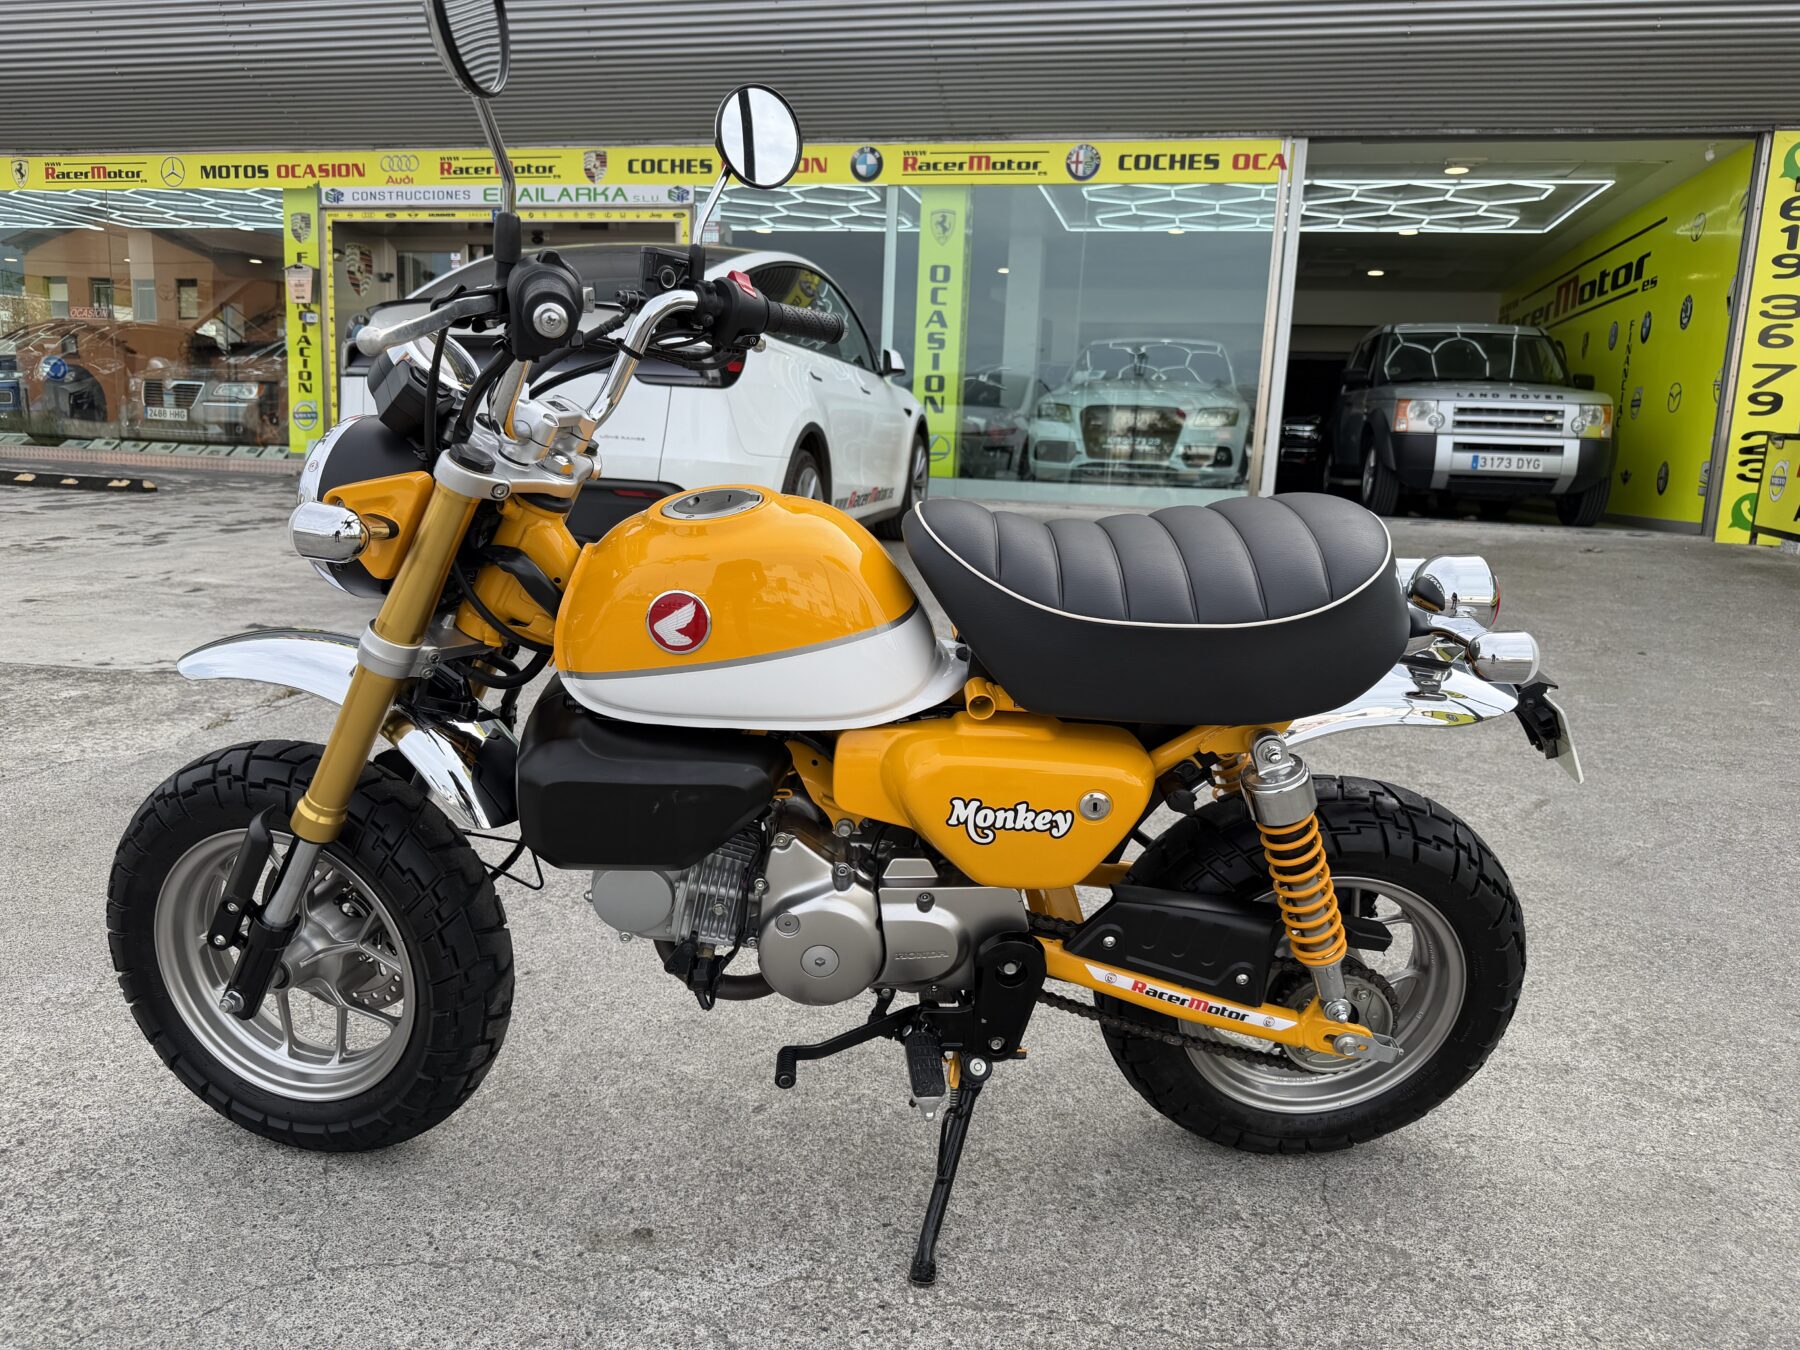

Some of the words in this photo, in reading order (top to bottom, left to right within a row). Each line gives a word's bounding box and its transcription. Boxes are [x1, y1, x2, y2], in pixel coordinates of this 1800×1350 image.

[439, 160, 557, 176] Racerotor
[627, 158, 713, 175] COCHES
[902, 154, 1042, 173] RacerMotor
[1117, 153, 1221, 171] COCHES
[1231, 152, 1288, 171] OCA
[44, 166, 143, 180] RacerMotor
[200, 164, 269, 180] MOTOS
[276, 162, 366, 179] OCASION
[385, 174, 415, 185] Audi
[351, 190, 472, 203] CONSTRUCCIONES
[482, 186, 629, 203] EAILARKA
[1641, 275, 1658, 292] es
[925, 264, 951, 414] OCASION
[1479, 456, 1513, 470] 3173
[1515, 457, 1541, 470] DYG
[946, 796, 1075, 846] Monkey
[894, 950, 950, 961] HONDA
[1130, 979, 1250, 1022] RacerMotor
